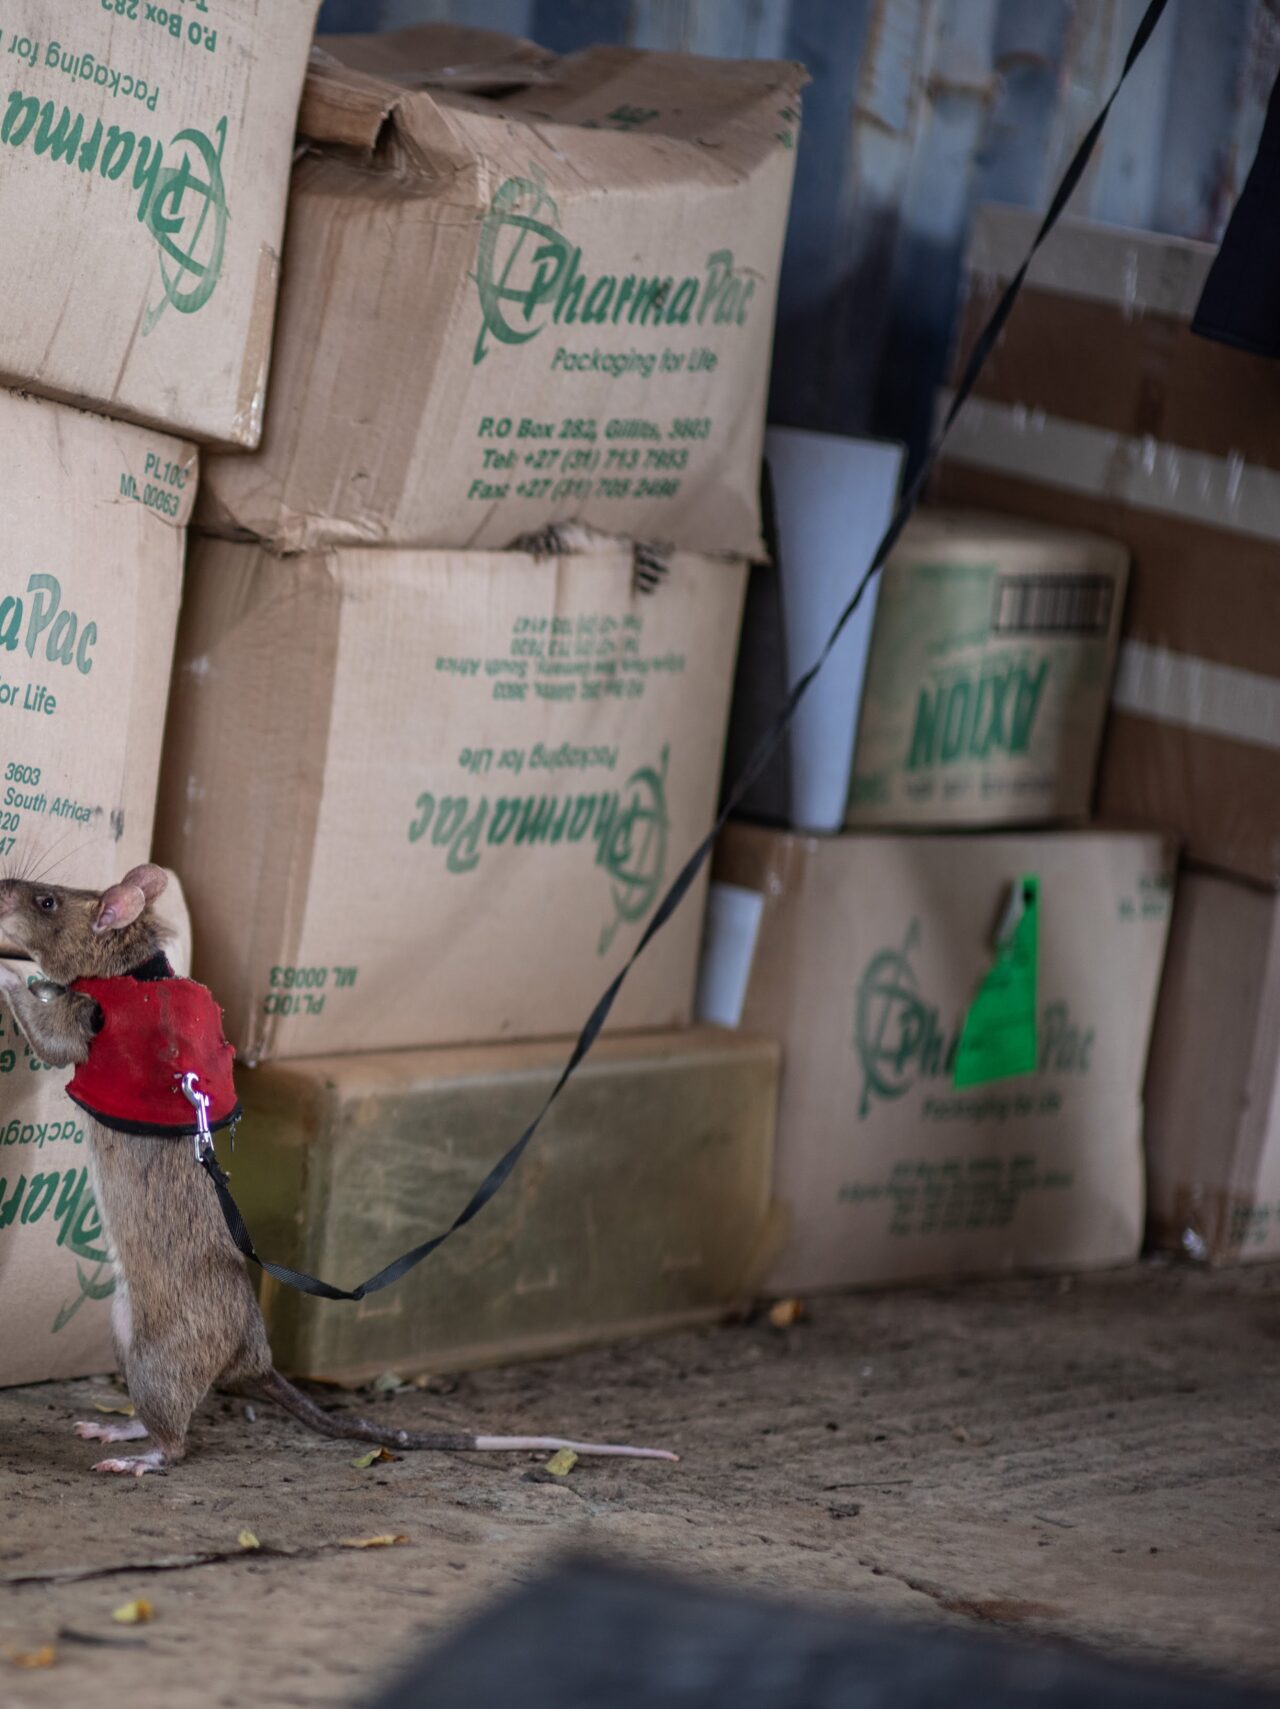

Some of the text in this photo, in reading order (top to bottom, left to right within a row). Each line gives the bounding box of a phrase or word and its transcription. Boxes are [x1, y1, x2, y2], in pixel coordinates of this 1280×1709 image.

[144, 3, 183, 38] Box
[8, 33, 39, 69] for
[188, 23, 218, 53] P.O
[45, 42, 160, 111] Packaging
[522, 245, 755, 327] PharmaPac
[551, 346, 718, 378] Packaging for Life
[517, 418, 554, 439] Box
[558, 417, 597, 442] 282,
[481, 449, 518, 471] Tel:
[523, 449, 558, 470] +27
[561, 448, 599, 473] (31)
[604, 449, 639, 470] 713
[120, 473, 180, 517] ML 00063
[515, 479, 550, 499] +27
[435, 656, 481, 677] Africa
[23, 684, 57, 716] Life
[5, 761, 41, 786] 3603
[458, 743, 619, 773] Packaging for Life
[3, 787, 47, 815] South
[49, 796, 91, 823] Africa
[409, 790, 635, 875] PharmaPac
[269, 966, 358, 988] ML 00063
